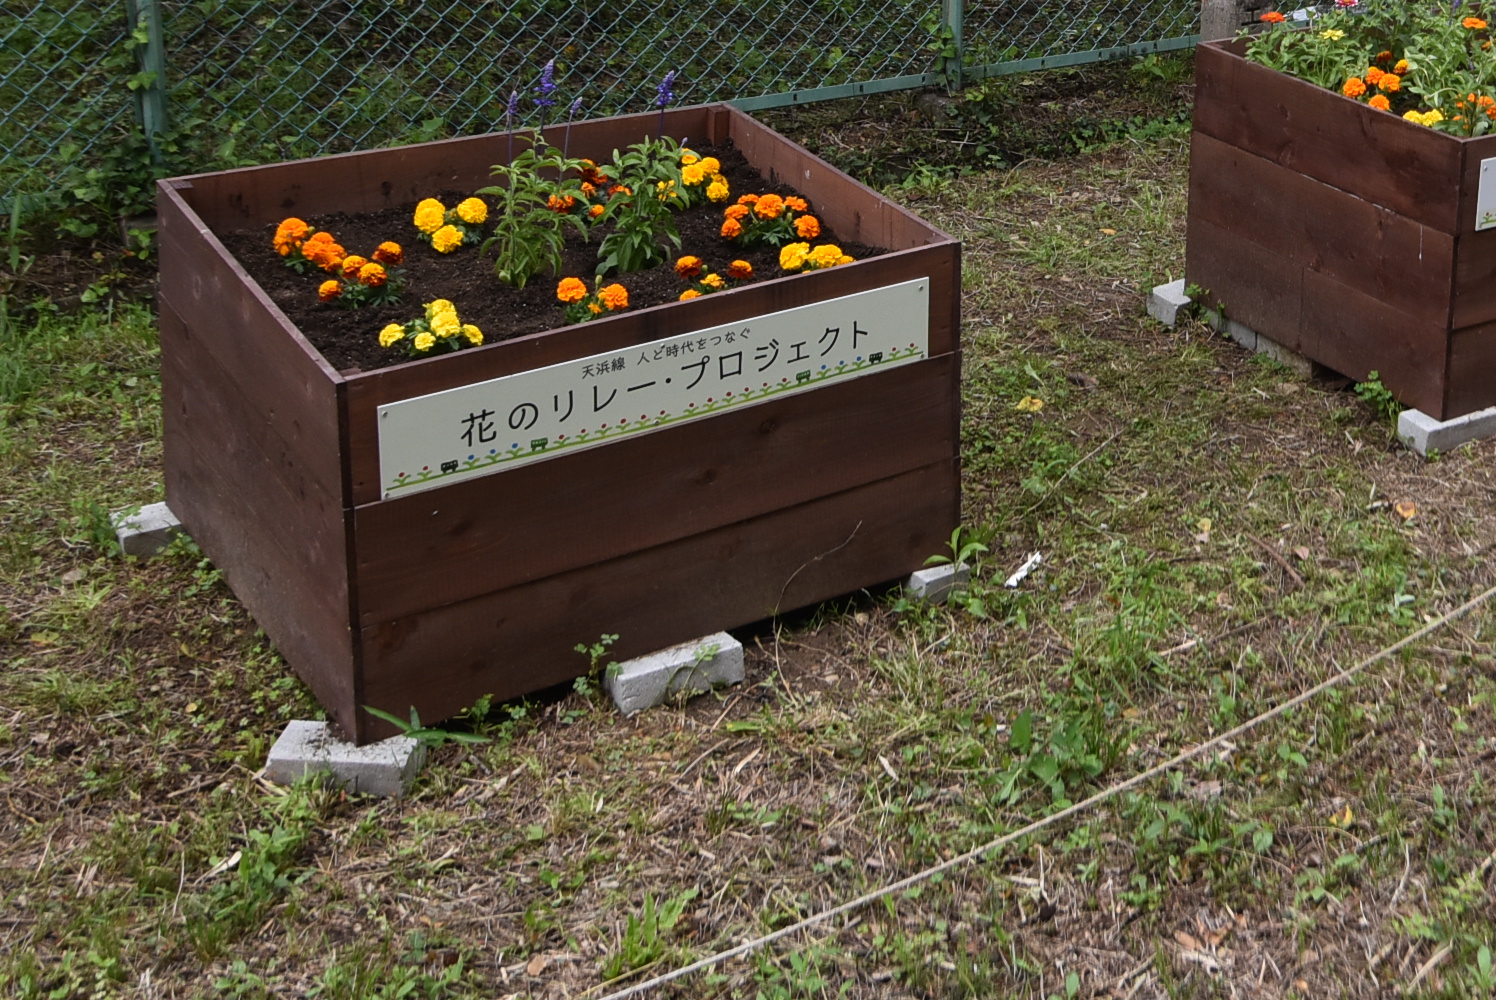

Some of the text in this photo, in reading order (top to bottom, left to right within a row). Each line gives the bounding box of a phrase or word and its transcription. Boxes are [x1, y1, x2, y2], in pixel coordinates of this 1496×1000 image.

[460, 320, 869, 448] 花のリレー・プロジェクト
[581, 327, 751, 380] 天浜線 人と時代をつなぐ
